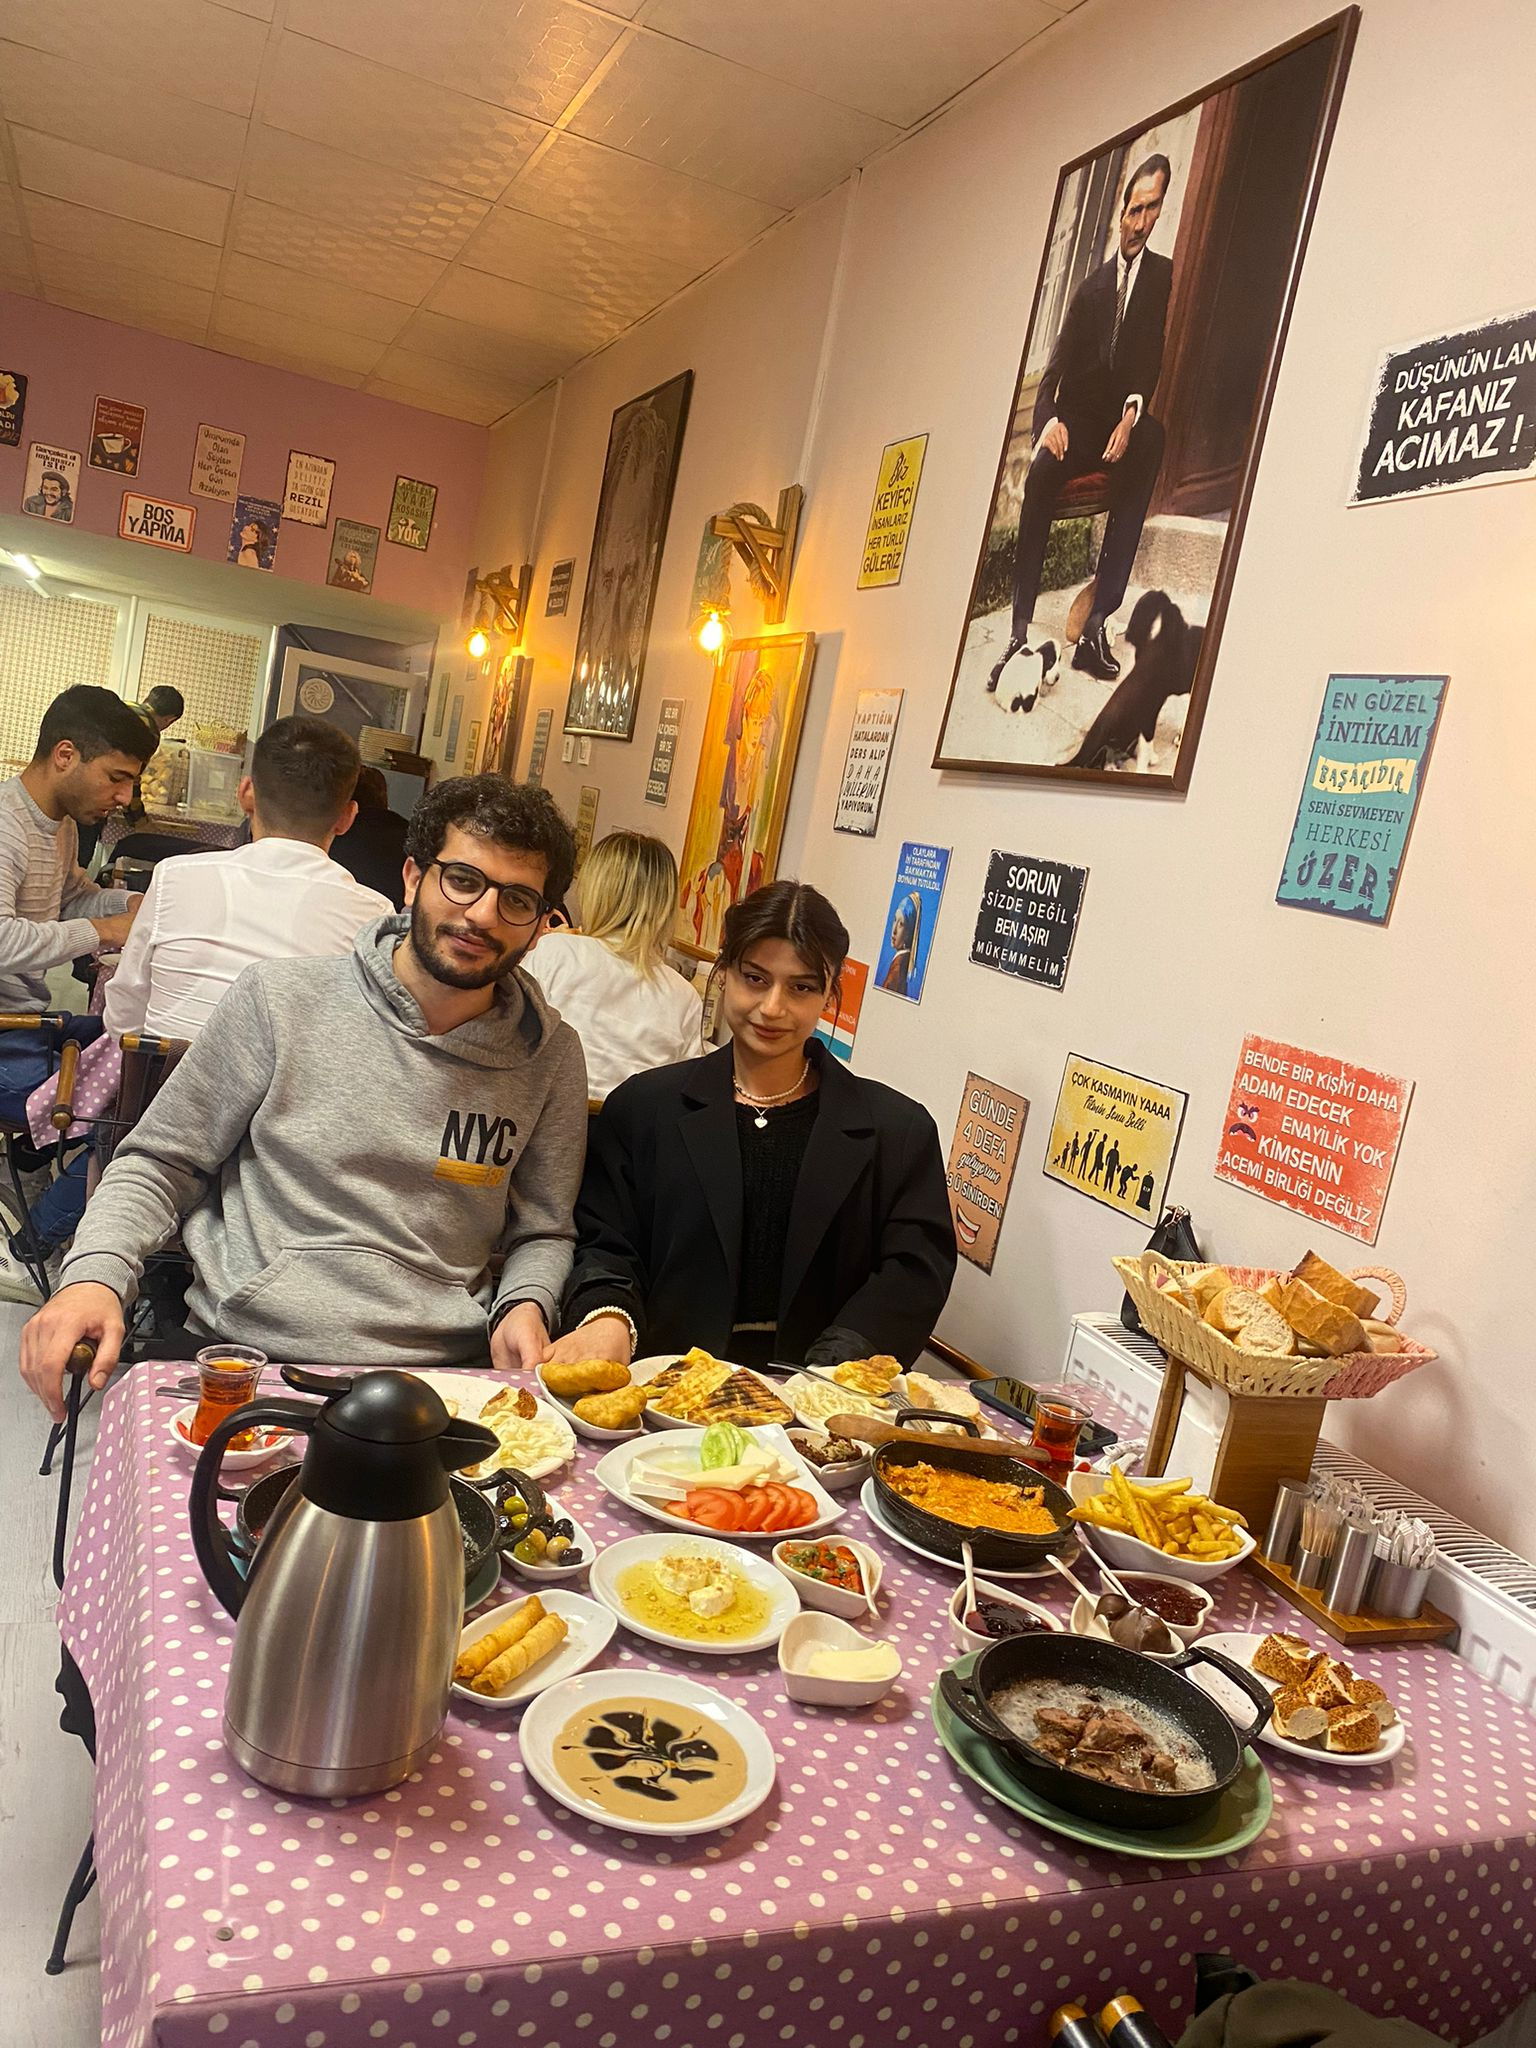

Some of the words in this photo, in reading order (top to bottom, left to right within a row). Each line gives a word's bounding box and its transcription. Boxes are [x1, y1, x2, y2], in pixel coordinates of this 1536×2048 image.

[1394, 348, 1492, 394] DÜŞÜNÜN
[1492, 339, 1536, 371] LAN
[1397, 376, 1517, 432] KAFANIZ
[1372, 417, 1506, 477] ACIMAZ
[290, 492, 324, 509] REZİL
[402, 491, 427, 509] VAR
[875, 481, 915, 513] KEYİFÇİ
[128, 515, 185, 544] YAPMA
[143, 503, 175, 526] BOŞ
[398, 524, 421, 545] YOK
[867, 536, 882, 550] HER
[882, 530, 905, 547] TÜRLÜ
[863, 549, 901, 574] GÜLERİZ
[857, 710, 893, 726] YAPTIĞIM
[1332, 691, 1356, 711] EN
[1364, 688, 1428, 714] GÜZEL
[1325, 714, 1423, 748] İNTİKAM
[849, 748, 868, 760] DERS
[868, 748, 886, 761] ALIP
[846, 763, 881, 782] DAHA
[1319, 765, 1405, 794] BAŞARIDIR
[1307, 799, 1338, 816] SENİ
[1338, 803, 1405, 825] SEVMEYEN
[912, 847, 937, 859] OLAYLARA
[1305, 822, 1392, 852] HERKESİ
[1006, 864, 1062, 898] SORUN
[1296, 850, 1379, 901] ÜZER
[986, 889, 1024, 914] SİZDE
[1027, 900, 1068, 925] DEĞİL
[995, 917, 1018, 938] BEN
[1019, 924, 1051, 947] AŞIRI
[975, 940, 1060, 977] MÜKEMMELİM
[1071, 1071, 1091, 1089] ÇOK
[1090, 1078, 1138, 1108] KASMAYIN
[1139, 1096, 1171, 1120] YAAAA
[1244, 1049, 1290, 1077] BENDE
[1291, 1062, 1315, 1086] BİR
[1356, 1085, 1398, 1113] DAHA
[969, 1088, 1017, 1131] GÜNDE
[1083, 1094, 1106, 1116] Filmin
[1124, 1110, 1147, 1132] Belli
[1238, 1072, 1284, 1103] ADAM
[1285, 1088, 1355, 1128] EDECEK
[440, 1110, 517, 1166] NYC
[963, 1120, 974, 1142] 4
[973, 1124, 1007, 1164] DEFA
[1281, 1116, 1350, 1155] ENAYİLİK
[1353, 1140, 1388, 1169] YOK
[957, 1151, 1001, 1184] gülüyorum
[1257, 1135, 1344, 1186] KİMSENİN
[946, 1171, 955, 1187] 3
[961, 1180, 1002, 1219] SİNİRDEN
[1222, 1151, 1265, 1181] ACEMİ
[1265, 1167, 1314, 1202] BİRLİĞİ
[1314, 1187, 1372, 1227] DEĞİLİZ
